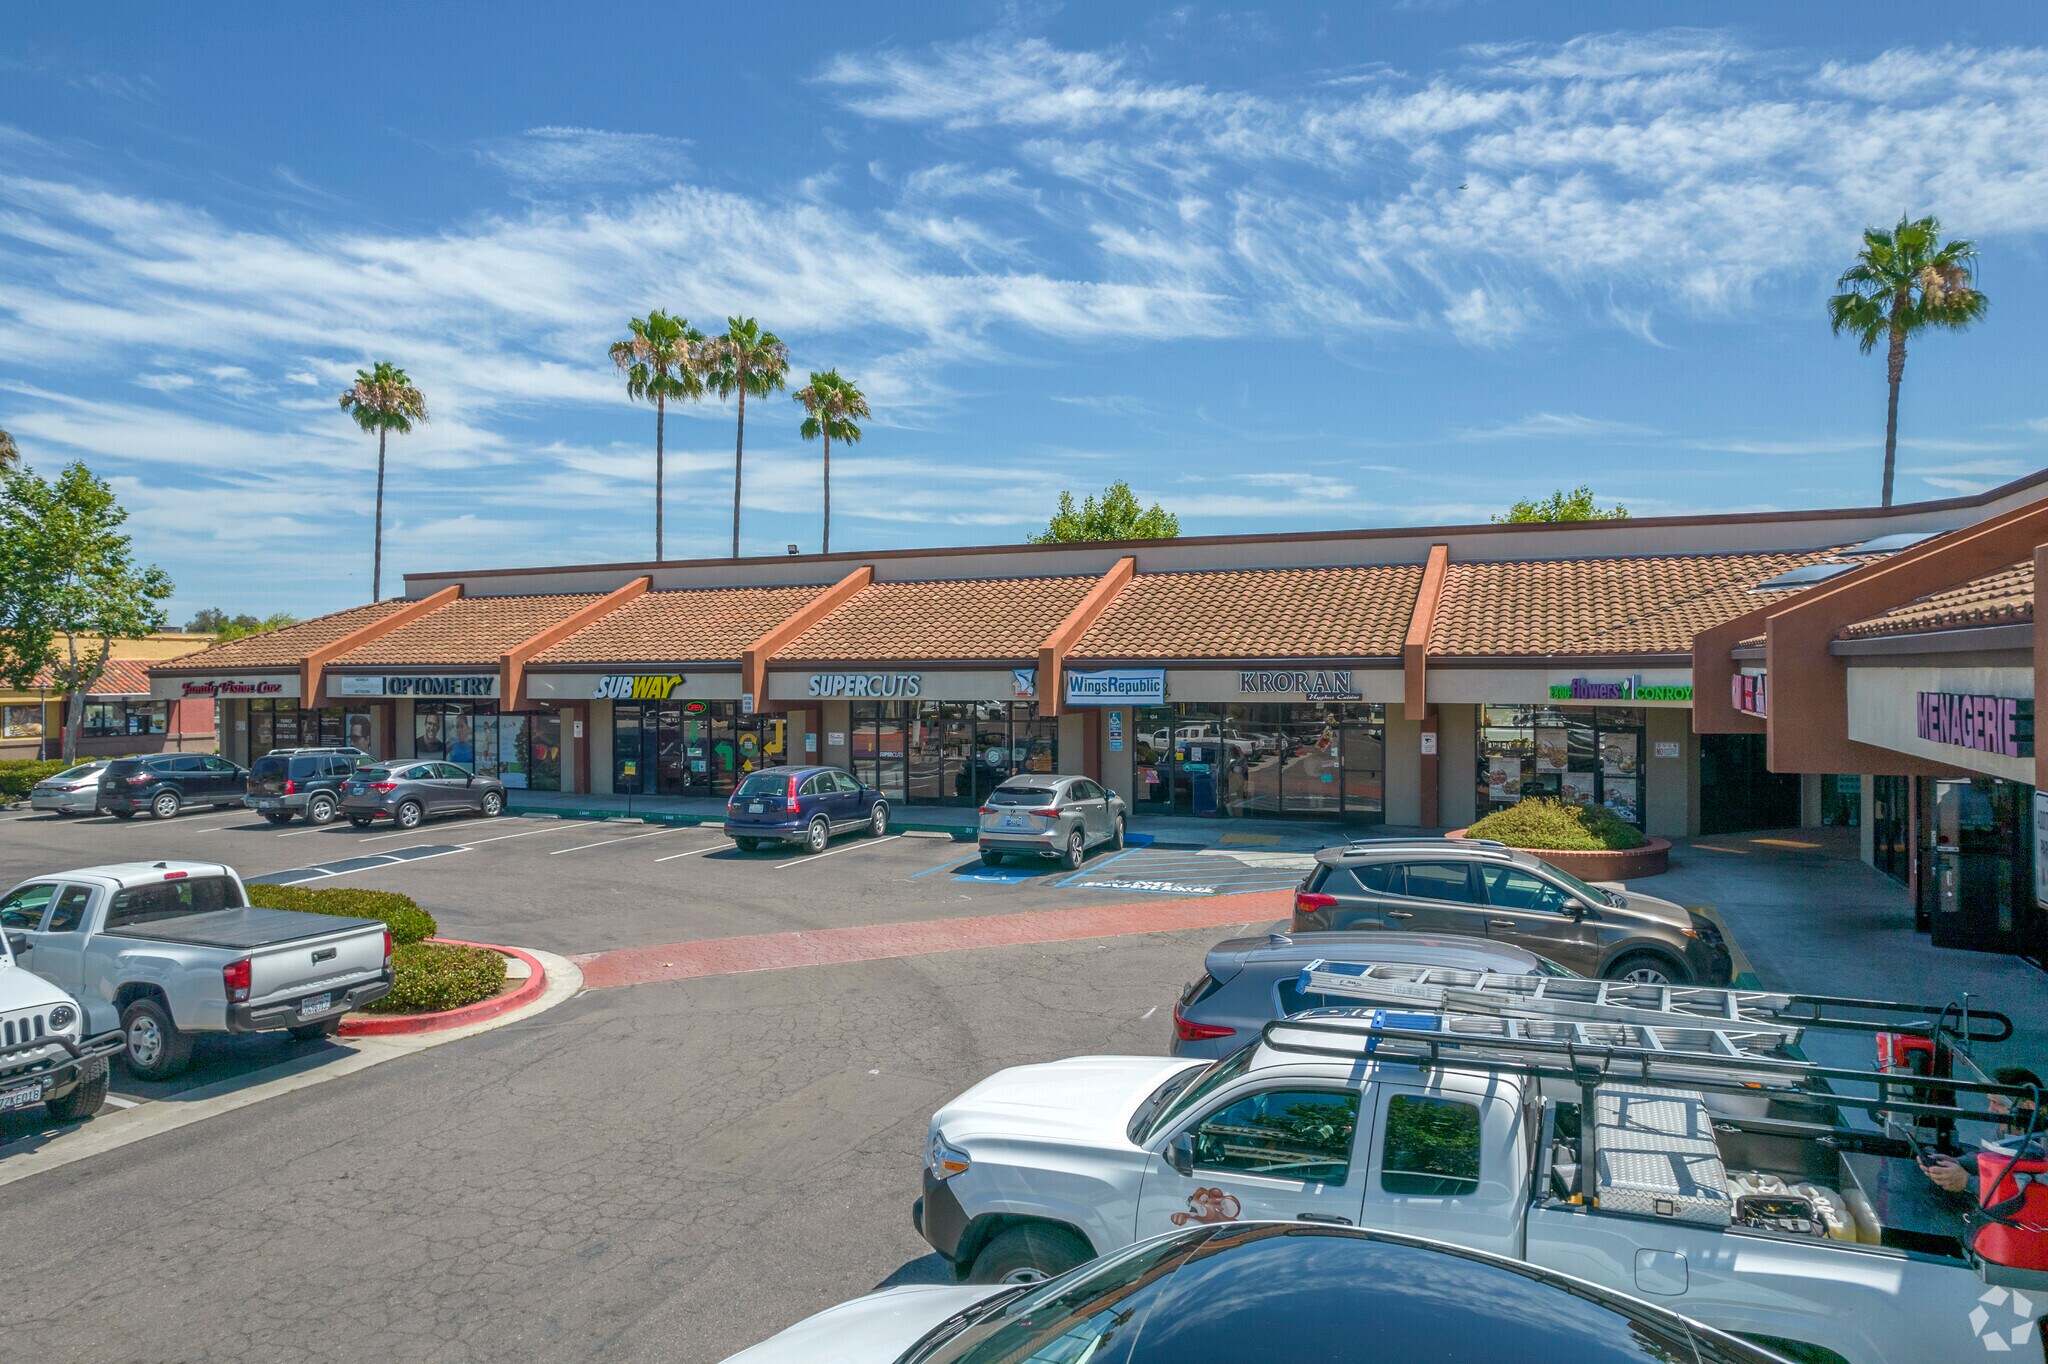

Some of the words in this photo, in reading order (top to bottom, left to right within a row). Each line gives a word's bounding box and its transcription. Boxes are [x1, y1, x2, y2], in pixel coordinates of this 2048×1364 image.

[181, 681, 218, 697] Family
[218, 680, 255, 694] Vision
[257, 681, 282, 694] Care
[388, 677, 494, 695] OPTOMETRY
[592, 672, 687, 699] SUBWAY
[808, 675, 922, 697] SUPERCUTS
[1070, 676, 1161, 694] WingsRepublic
[1239, 671, 1351, 693] KRORAN
[1917, 691, 2019, 758] MENAGERIE
